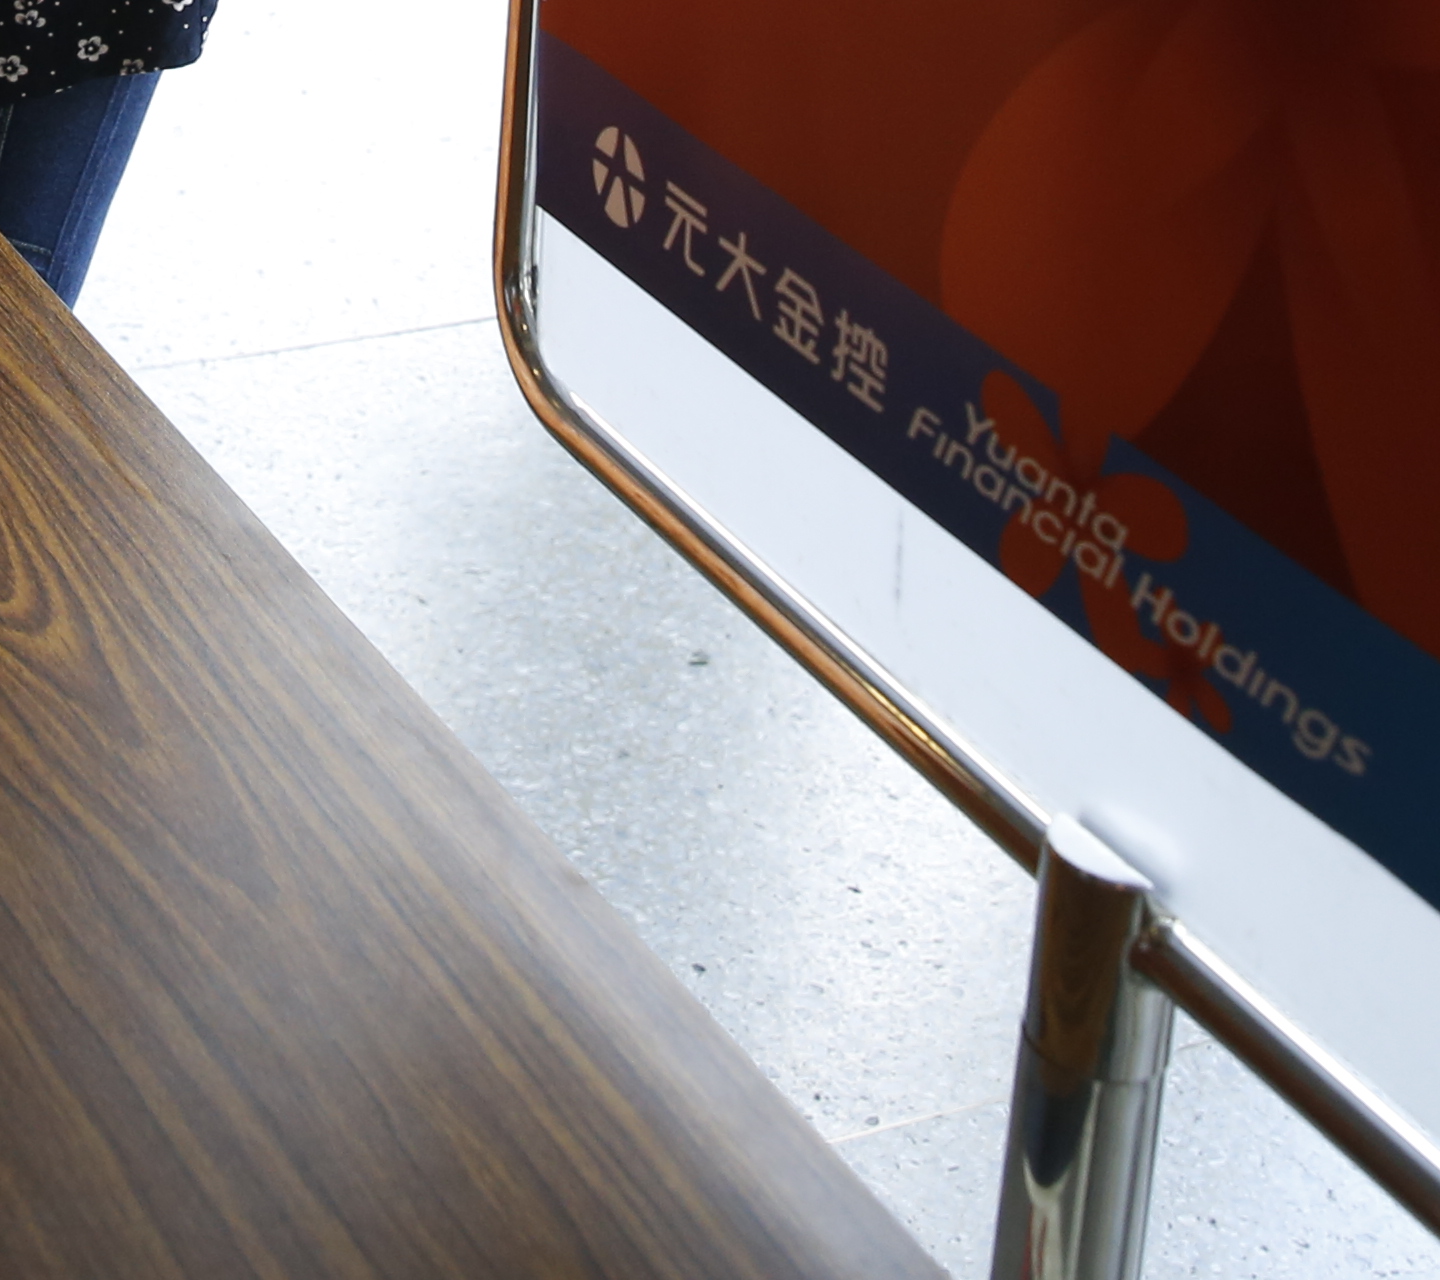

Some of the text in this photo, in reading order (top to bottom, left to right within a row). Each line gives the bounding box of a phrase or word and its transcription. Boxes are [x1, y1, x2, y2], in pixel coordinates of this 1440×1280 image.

[662, 180, 888, 412] 元大金控
[907, 406, 1371, 778] Financial Holdings
[963, 402, 1127, 551] Yuanta
